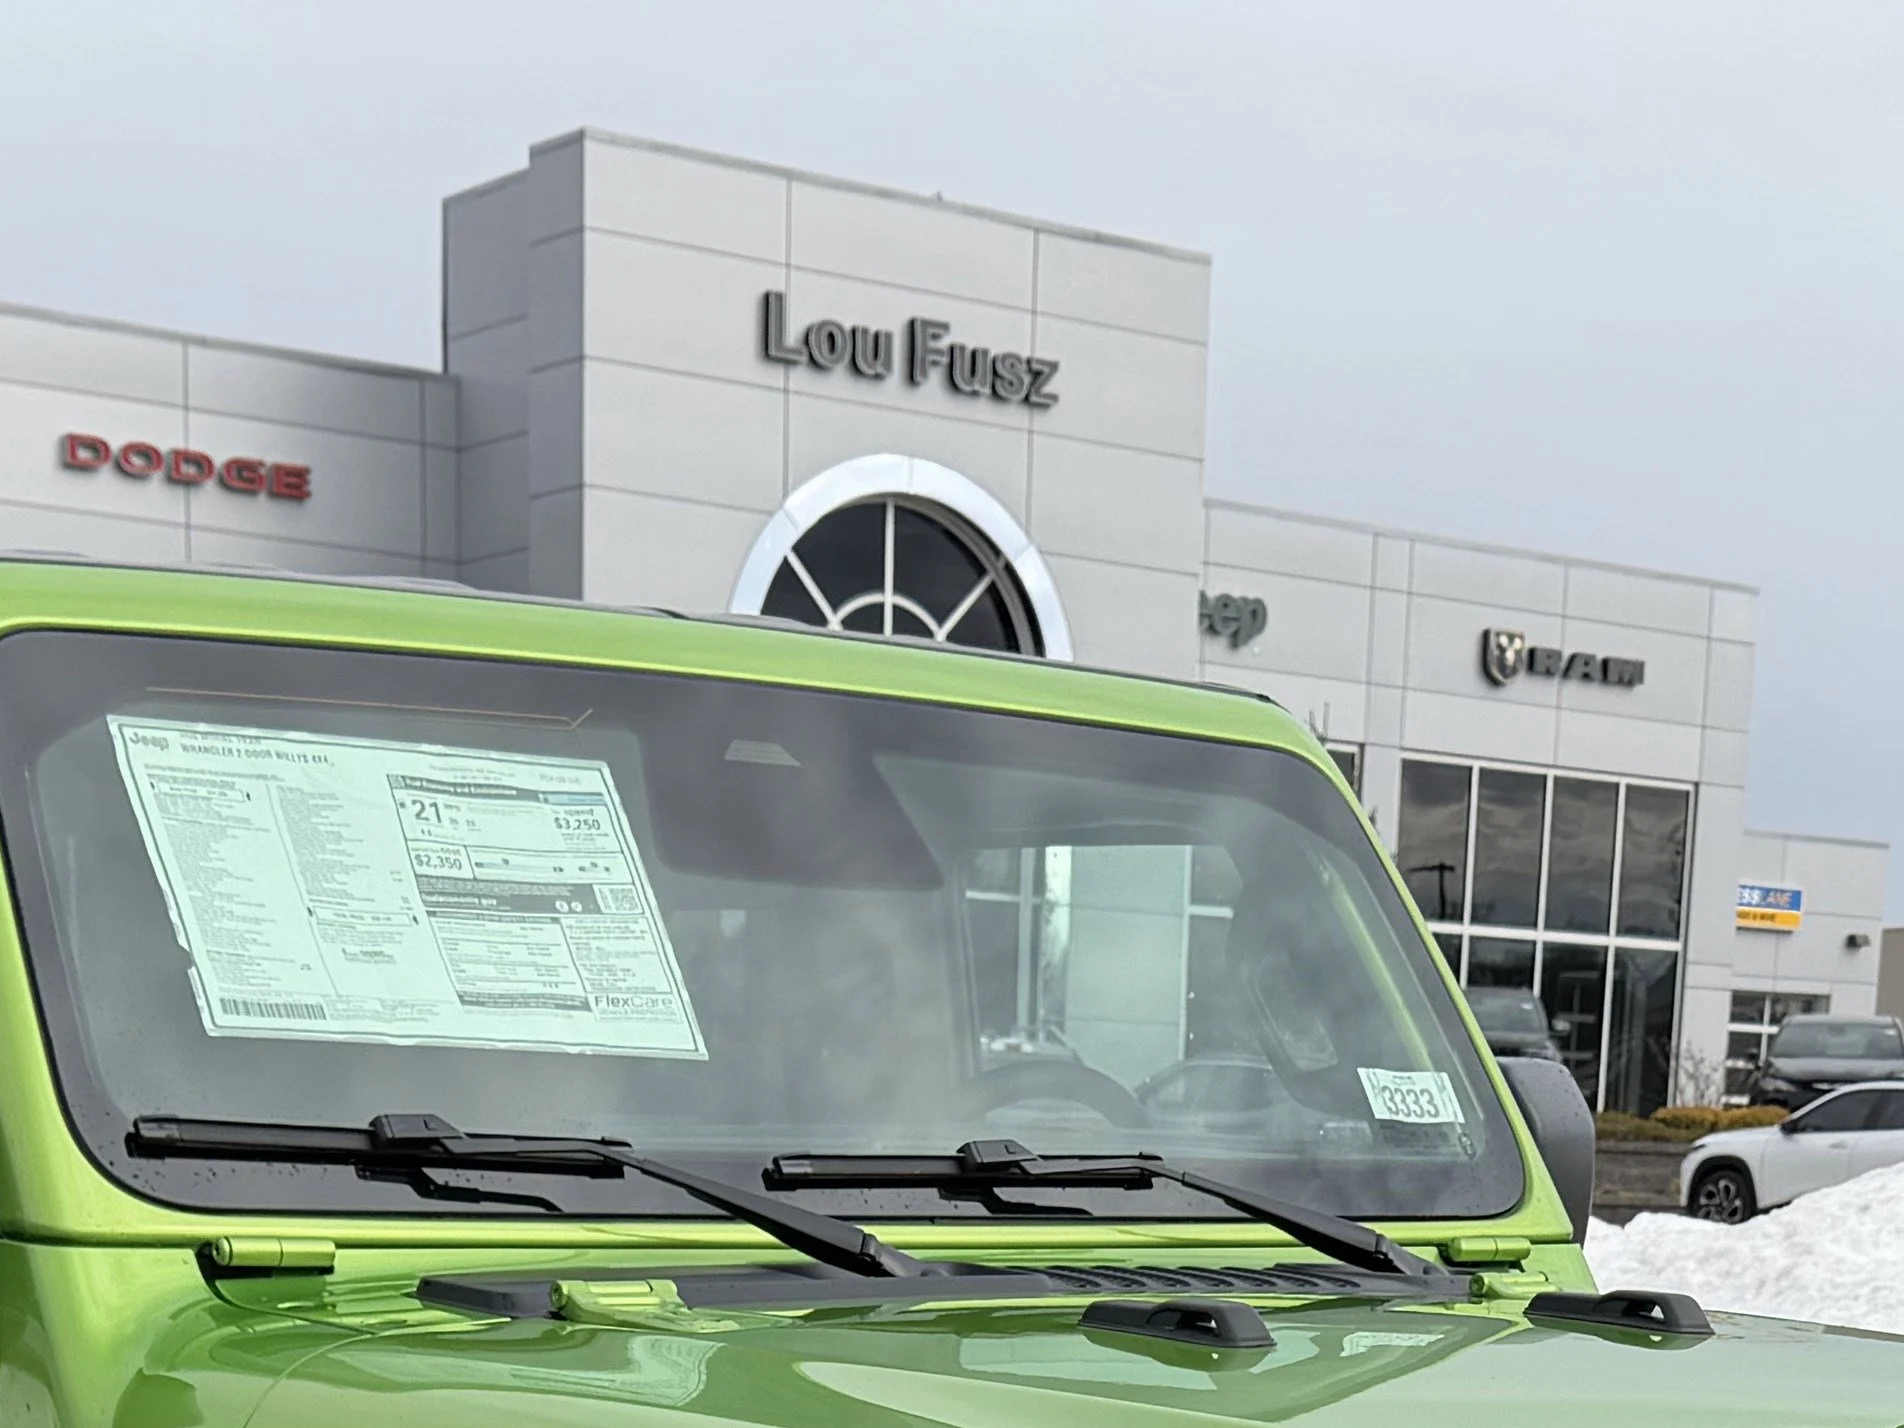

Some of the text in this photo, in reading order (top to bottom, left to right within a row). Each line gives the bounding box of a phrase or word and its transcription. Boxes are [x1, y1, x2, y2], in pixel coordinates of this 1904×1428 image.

[760, 290, 1060, 409] Lou Fusz
[61, 433, 313, 500] DODGE
[1526, 646, 1646, 687] RAM
[130, 732, 169, 751] Jeep
[411, 799, 443, 825] 21
[553, 816, 601, 832] $3,250
[414, 853, 463, 871] $2,350
[595, 995, 673, 1009] FlexCare
[1381, 1085, 1440, 1119] 3333
